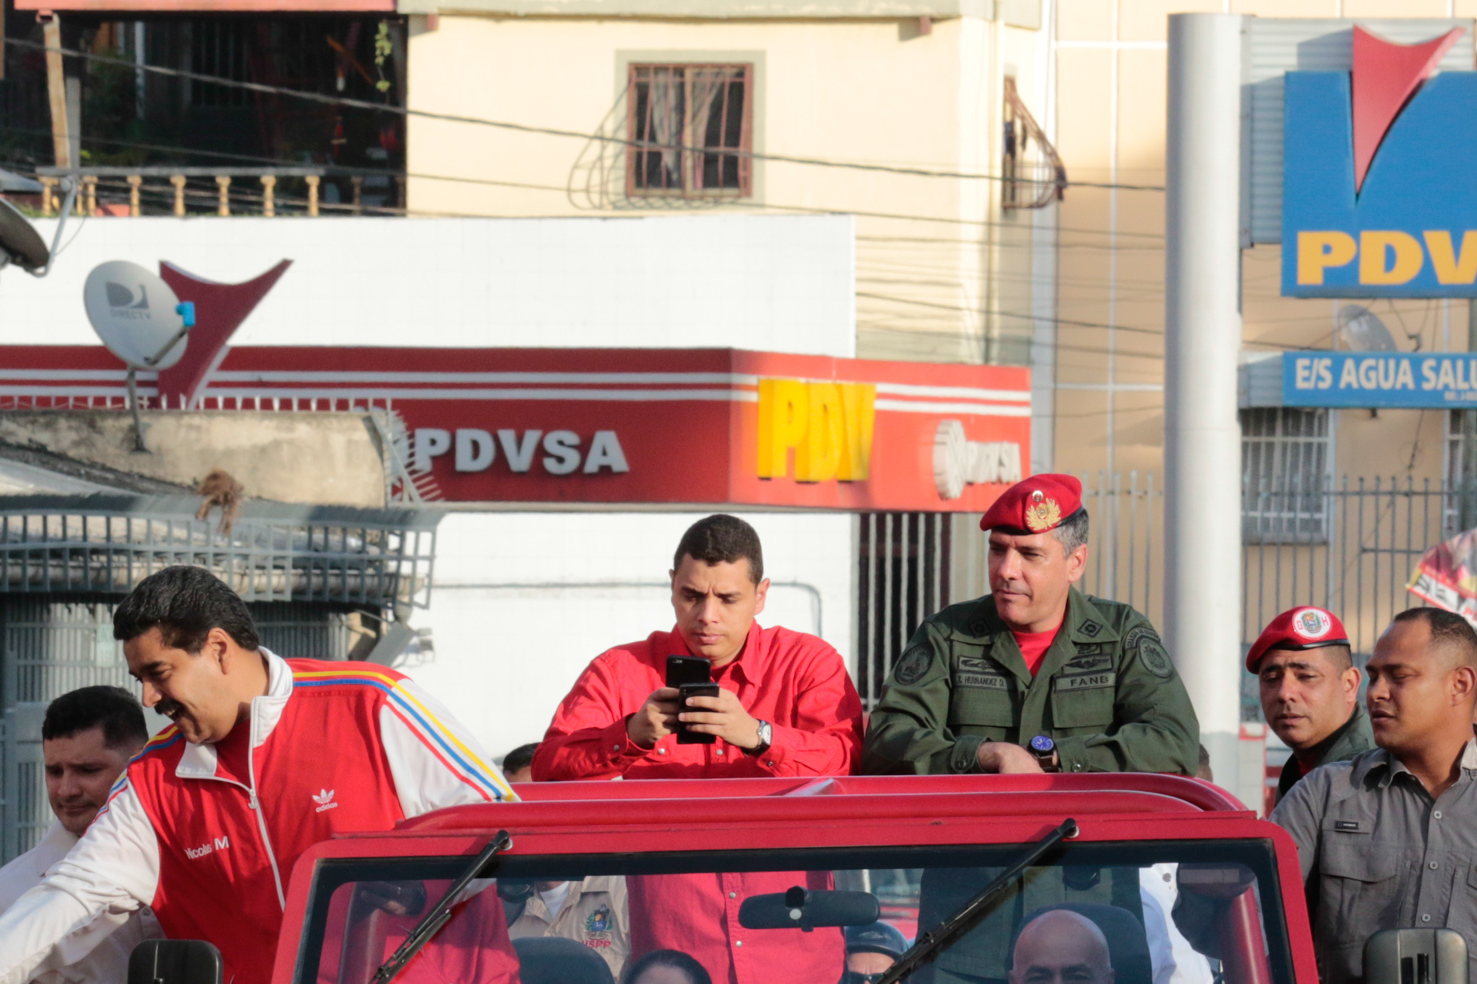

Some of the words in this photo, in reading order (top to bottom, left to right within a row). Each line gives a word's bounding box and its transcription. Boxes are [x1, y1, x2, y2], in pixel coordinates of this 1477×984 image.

[1295, 358, 1333, 390] E/S
[1339, 358, 1415, 390] AGUA
[415, 428, 630, 475] PDVSA
[1070, 675, 1109, 688] FANB
[315, 802, 338, 812] adidas
[214, 835, 230, 851] M
